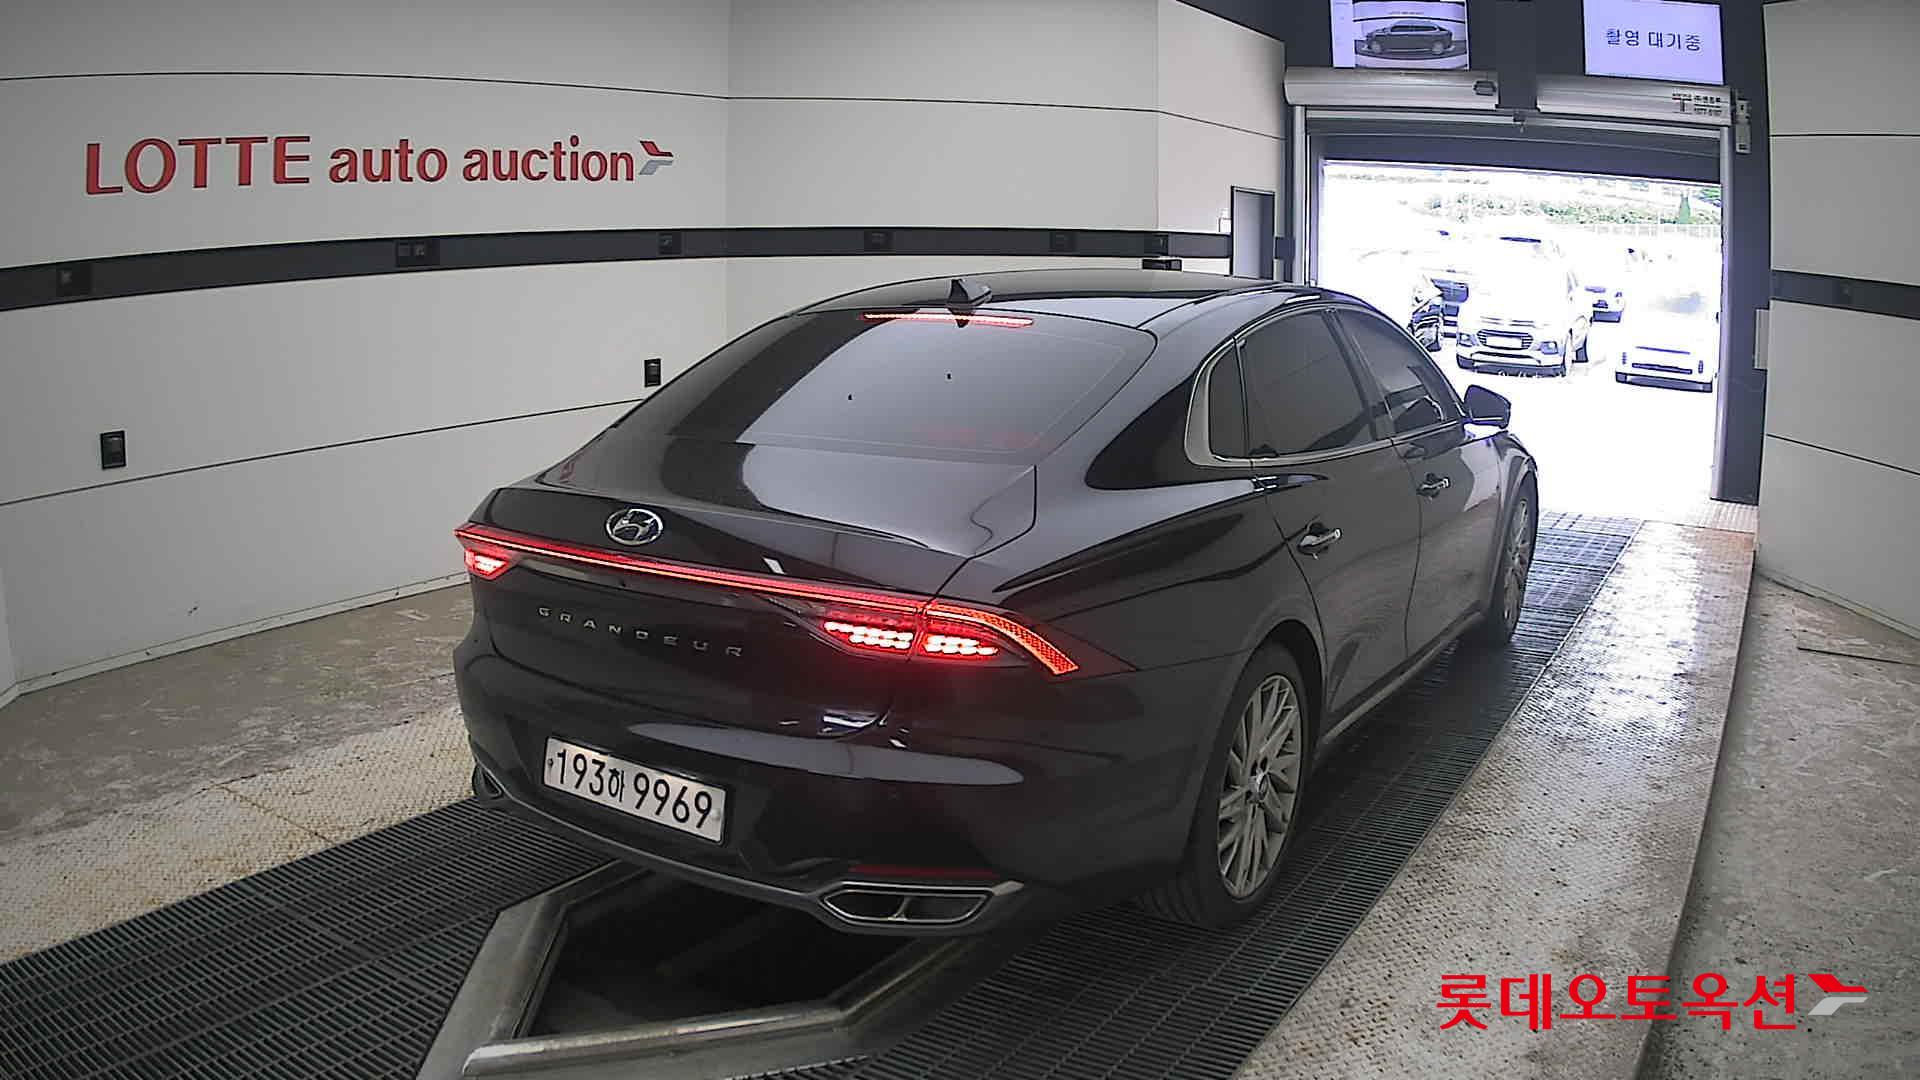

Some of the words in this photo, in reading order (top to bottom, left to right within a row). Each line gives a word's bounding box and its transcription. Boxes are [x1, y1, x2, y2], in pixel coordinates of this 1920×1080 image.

[1648, 31, 1701, 51] 대기중
[85, 135, 310, 194] LOTTE
[329, 138, 447, 182] auto
[463, 135, 634, 182] auction
[538, 607, 742, 656] GRANDEUR
[557, 748, 625, 802] 193하
[633, 772, 713, 829] 9969
